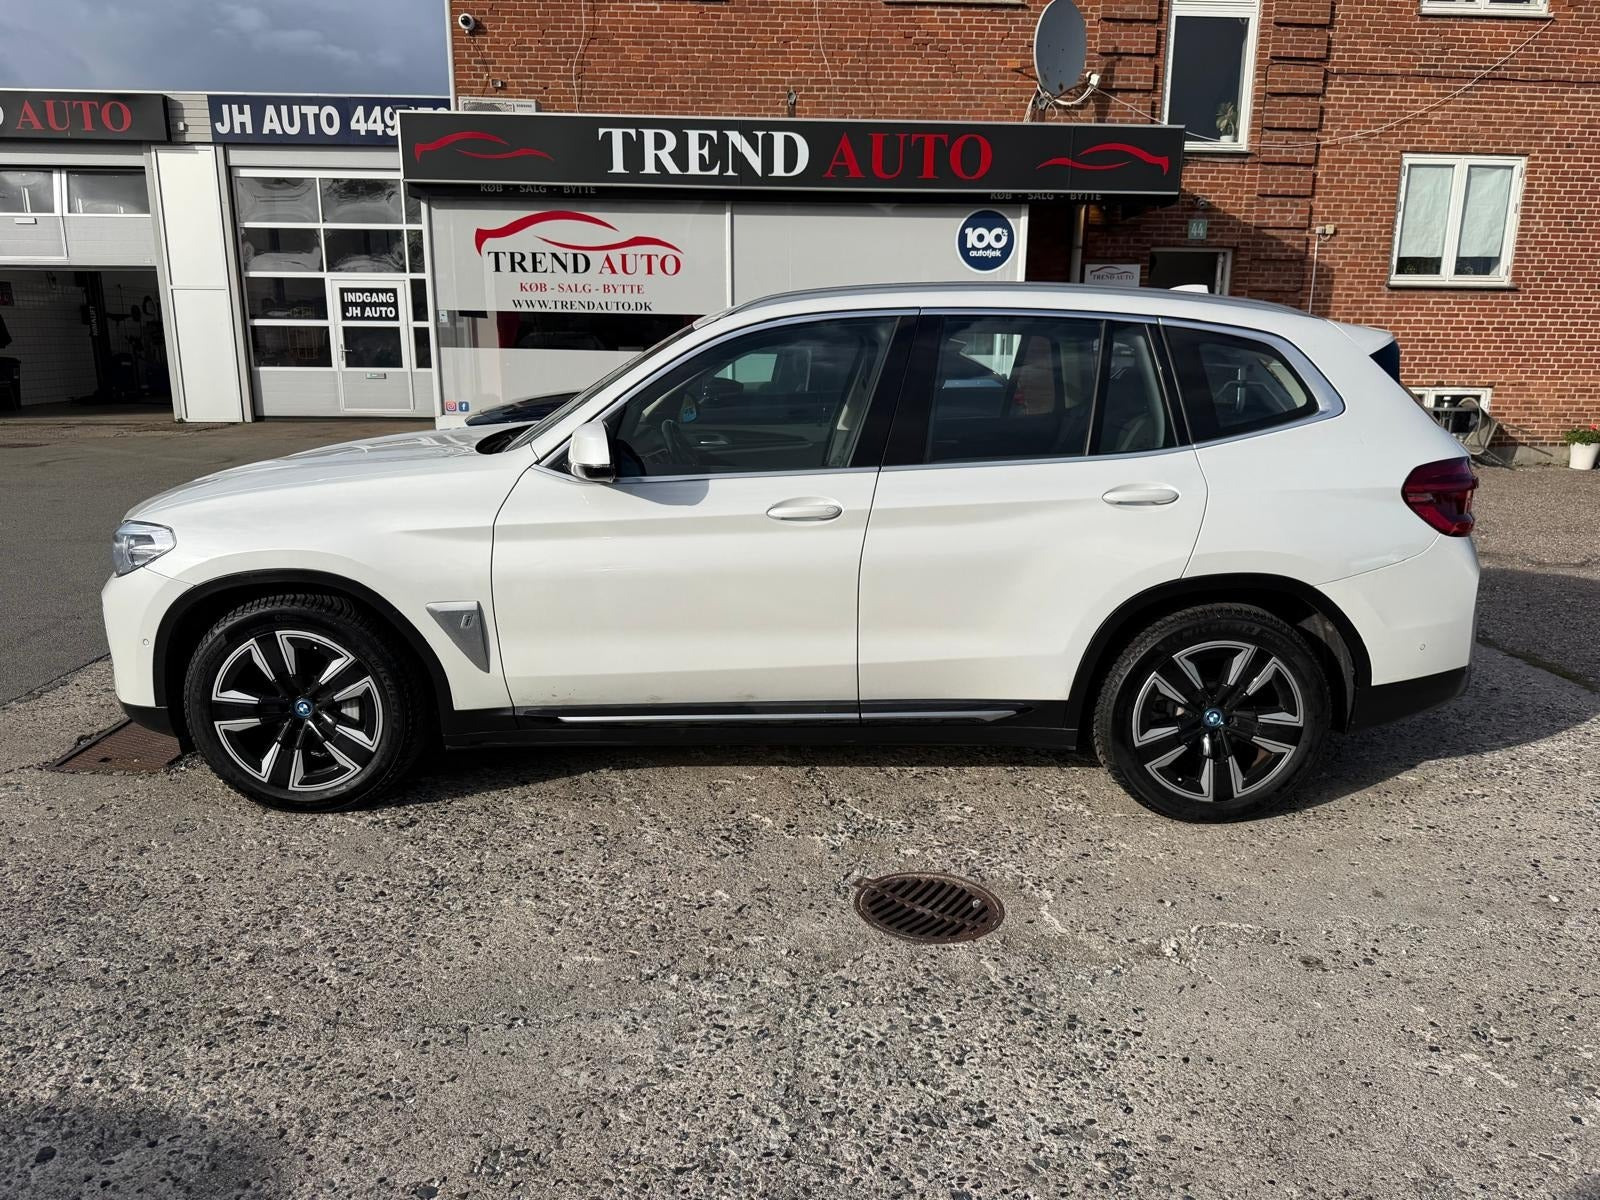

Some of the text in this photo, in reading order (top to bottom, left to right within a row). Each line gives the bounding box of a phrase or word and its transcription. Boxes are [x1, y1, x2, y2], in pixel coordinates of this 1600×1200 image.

[16, 99, 133, 132] AUTO
[215, 104, 253, 134] JH
[262, 104, 340, 135] AUTO
[598, 127, 993, 181] TREND AUTO
[519, 184, 547, 193] SALG
[563, 185, 597, 194] BYTTE
[1027, 192, 1055, 200] SALG
[1191, 223, 1204, 236] 44
[969, 249, 1001, 258] autotjek
[488, 251, 682, 276] TREND AUTO
[520, 282, 548, 293] KØB
[557, 283, 592, 294] SALG
[602, 284, 645, 295] BYTTE
[344, 292, 395, 303] INDGANG
[345, 306, 396, 318] JH AUTO
[512, 299, 653, 312] WWW.TRENDAUTO.DK
